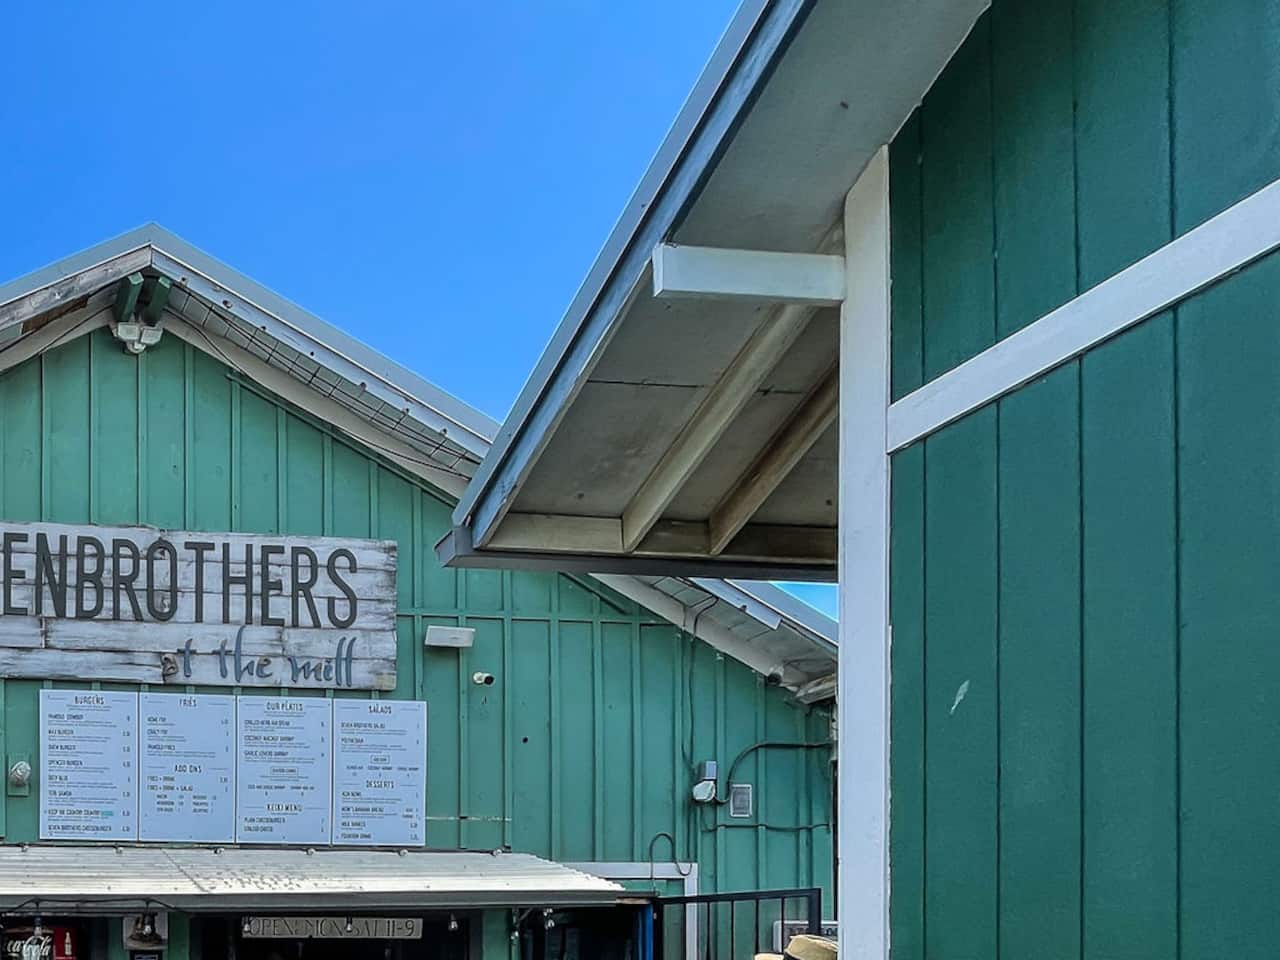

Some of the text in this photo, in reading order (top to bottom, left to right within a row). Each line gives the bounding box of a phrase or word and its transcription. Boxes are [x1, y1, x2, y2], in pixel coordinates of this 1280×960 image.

[211, 624, 272, 683] the
[288, 637, 358, 688] mill
[74, 695, 105, 705] BURGERS
[179, 698, 197, 707] FRIES
[266, 701, 304, 712] OUR PLATES
[368, 704, 392, 714] SALADS
[175, 764, 202, 773] ADD ONS
[366, 780, 395, 789] DESSERTS
